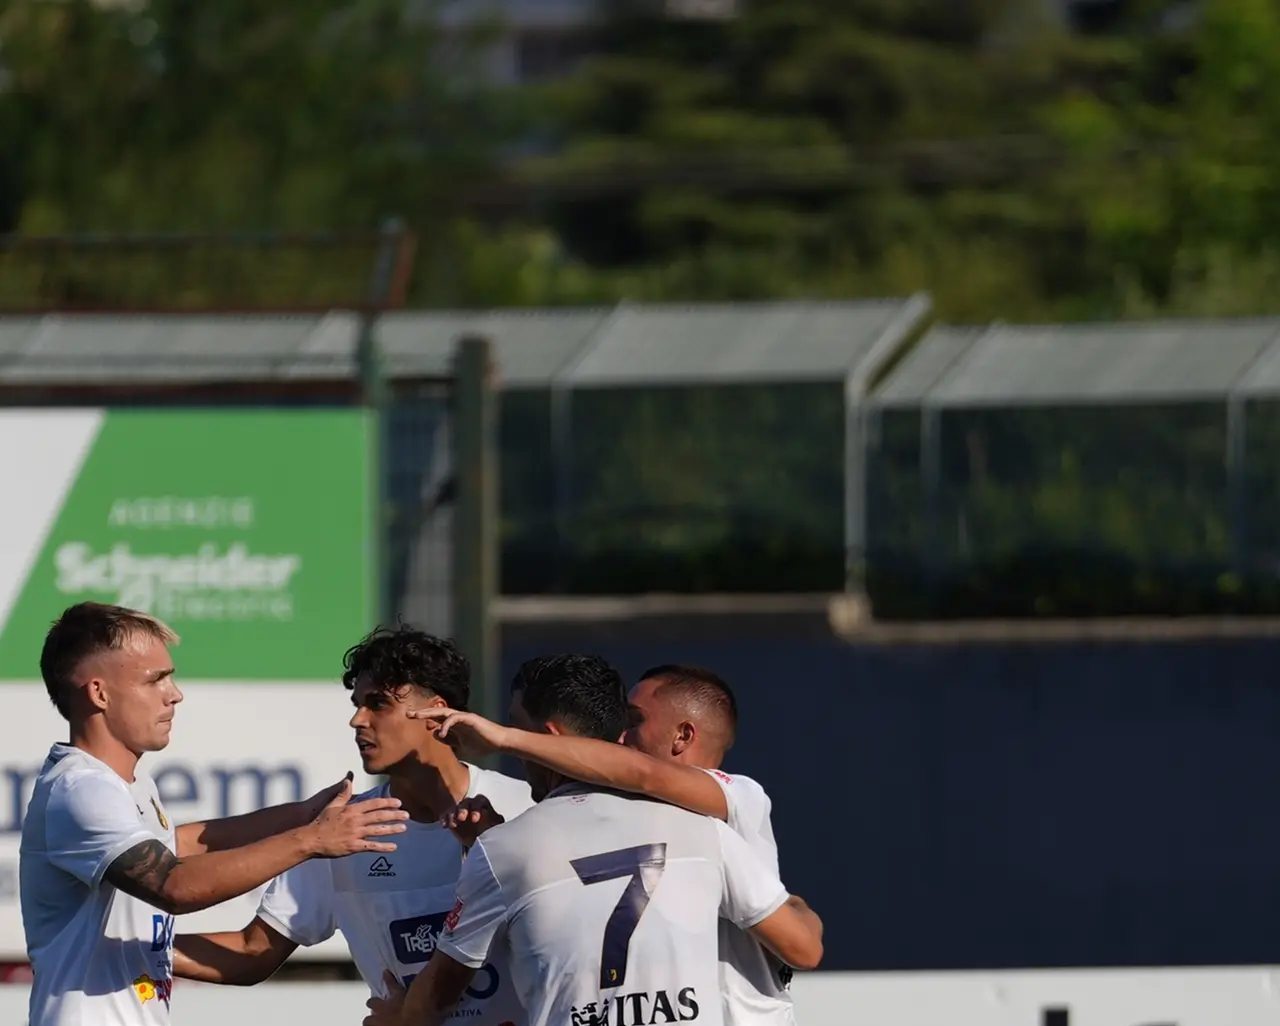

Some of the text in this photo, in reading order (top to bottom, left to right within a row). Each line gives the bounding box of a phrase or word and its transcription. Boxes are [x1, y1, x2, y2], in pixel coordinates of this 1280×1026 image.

[55, 542, 301, 593] Schneider
[399, 928, 441, 954] TREN
[569, 842, 668, 990] 7
